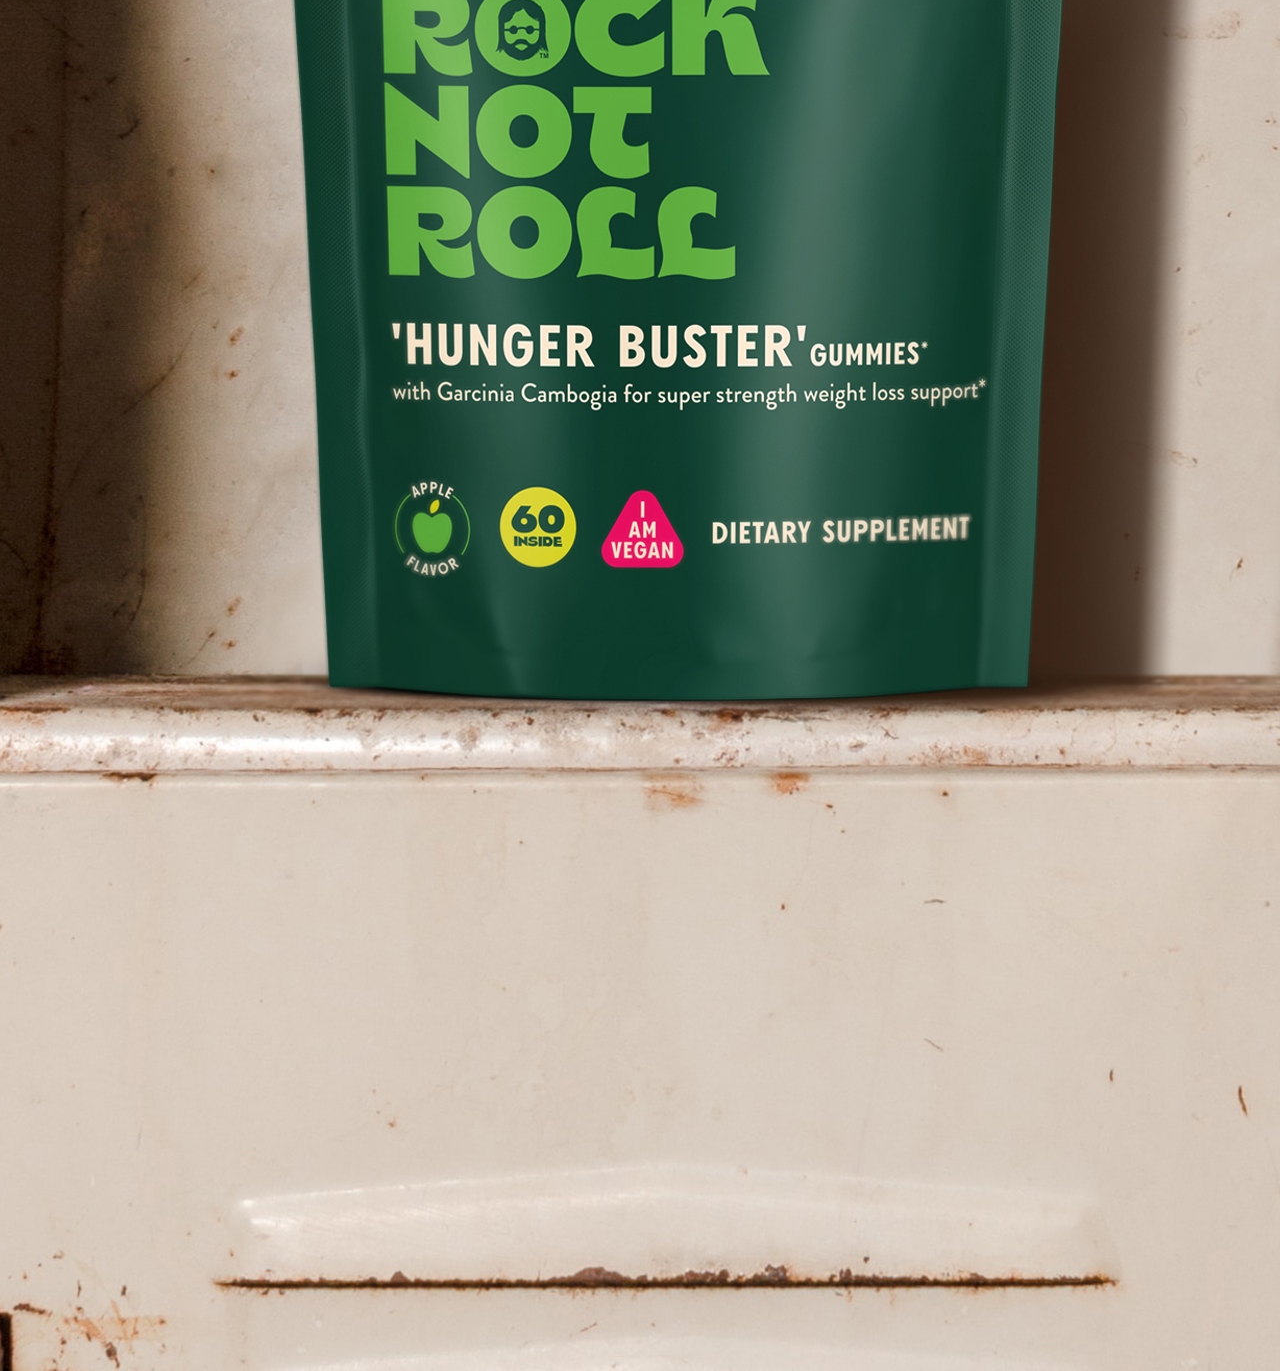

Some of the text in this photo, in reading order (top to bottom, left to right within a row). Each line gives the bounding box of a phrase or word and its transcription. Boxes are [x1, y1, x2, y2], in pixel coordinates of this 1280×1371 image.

[383, 81, 653, 180] NOT
[386, 185, 736, 281] ROLL
[391, 322, 595, 368] 'HUNGER
[619, 324, 807, 369] BUSTER'
[392, 381, 431, 401] with
[437, 381, 515, 403] Garcinia
[521, 383, 618, 411] Cambogia
[623, 383, 652, 403] for
[657, 390, 711, 411] super
[716, 383, 798, 411] strength
[803, 382, 867, 410] weight
[872, 381, 906, 402] loss
[410, 481, 455, 500] APPLE
[511, 505, 566, 534] 60
[640, 501, 646, 519] I
[513, 536, 563, 548] INSIDE
[628, 521, 657, 539] AM
[712, 515, 971, 545] DIETARY SUPPLEMENT
[611, 541, 674, 560] VEGAN
[405, 554, 460, 577] FLAVOR
